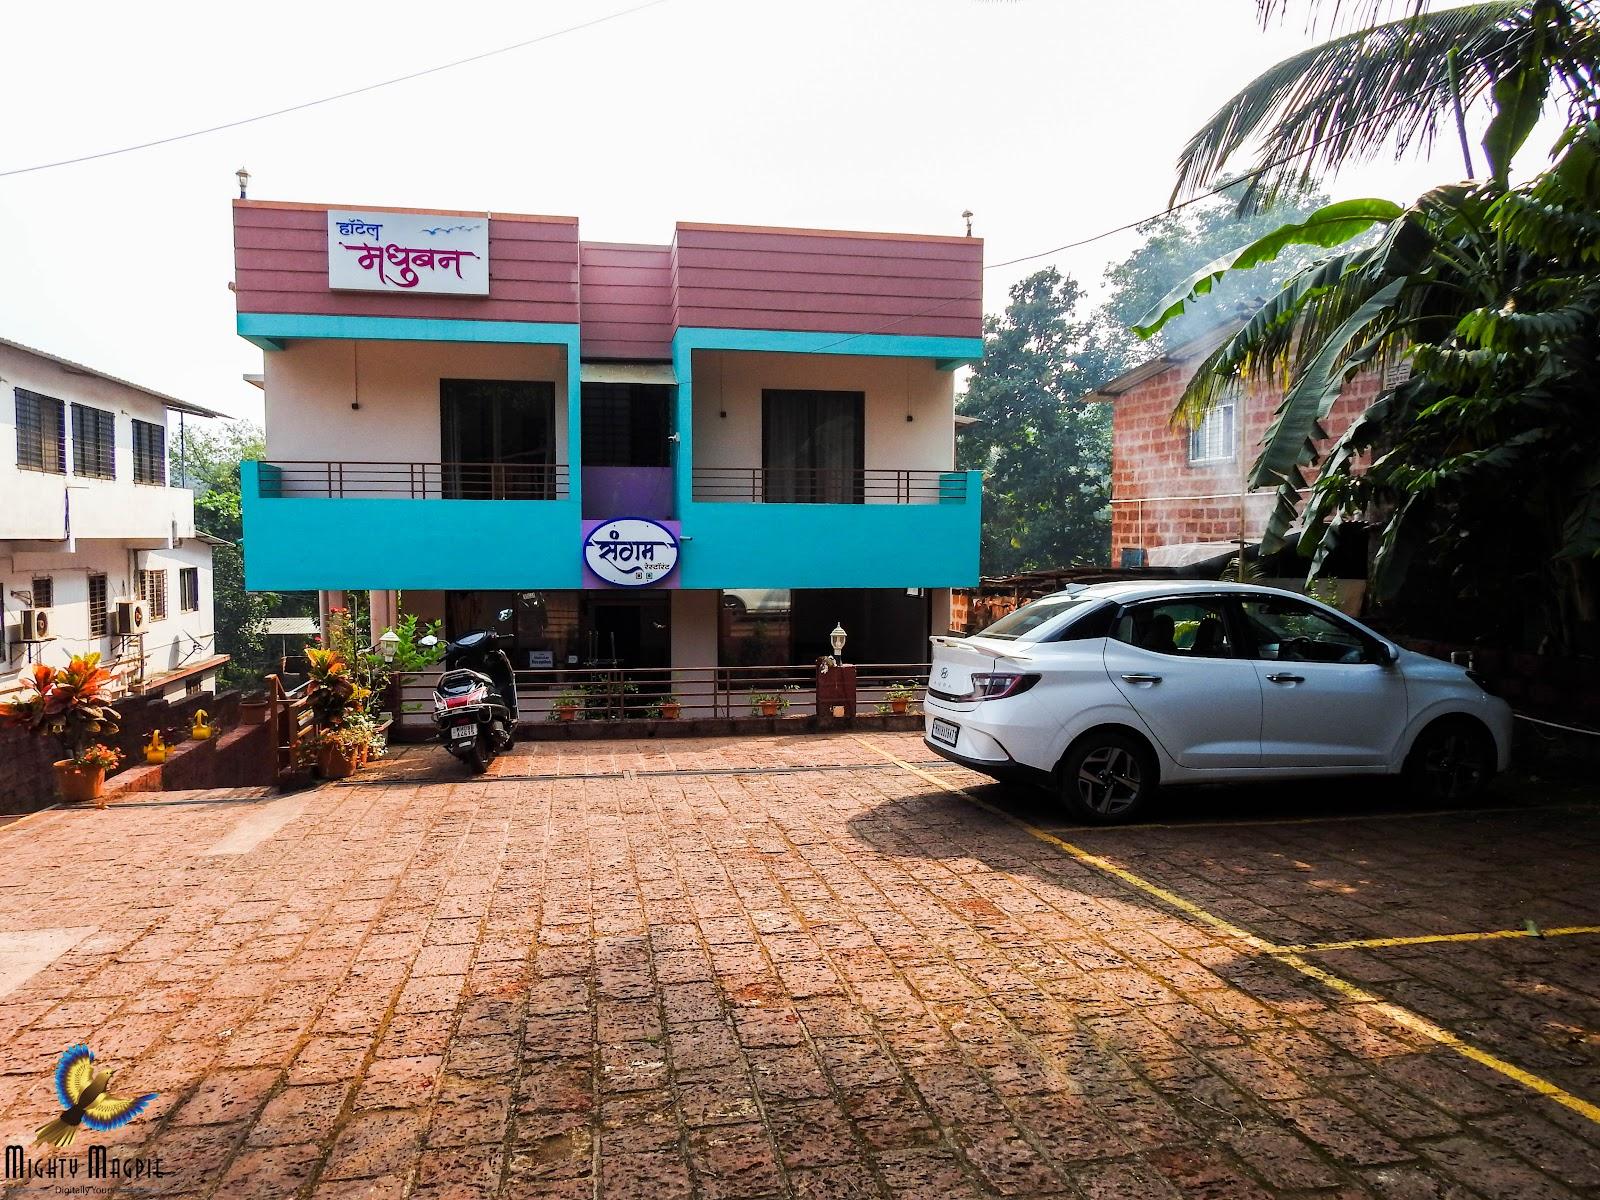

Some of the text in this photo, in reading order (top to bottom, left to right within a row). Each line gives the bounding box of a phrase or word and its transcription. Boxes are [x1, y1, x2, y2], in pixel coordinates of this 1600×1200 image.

[336, 219, 383, 241] हॉटेल
[339, 242, 480, 288] मधुबन
[592, 530, 669, 574] संगम
